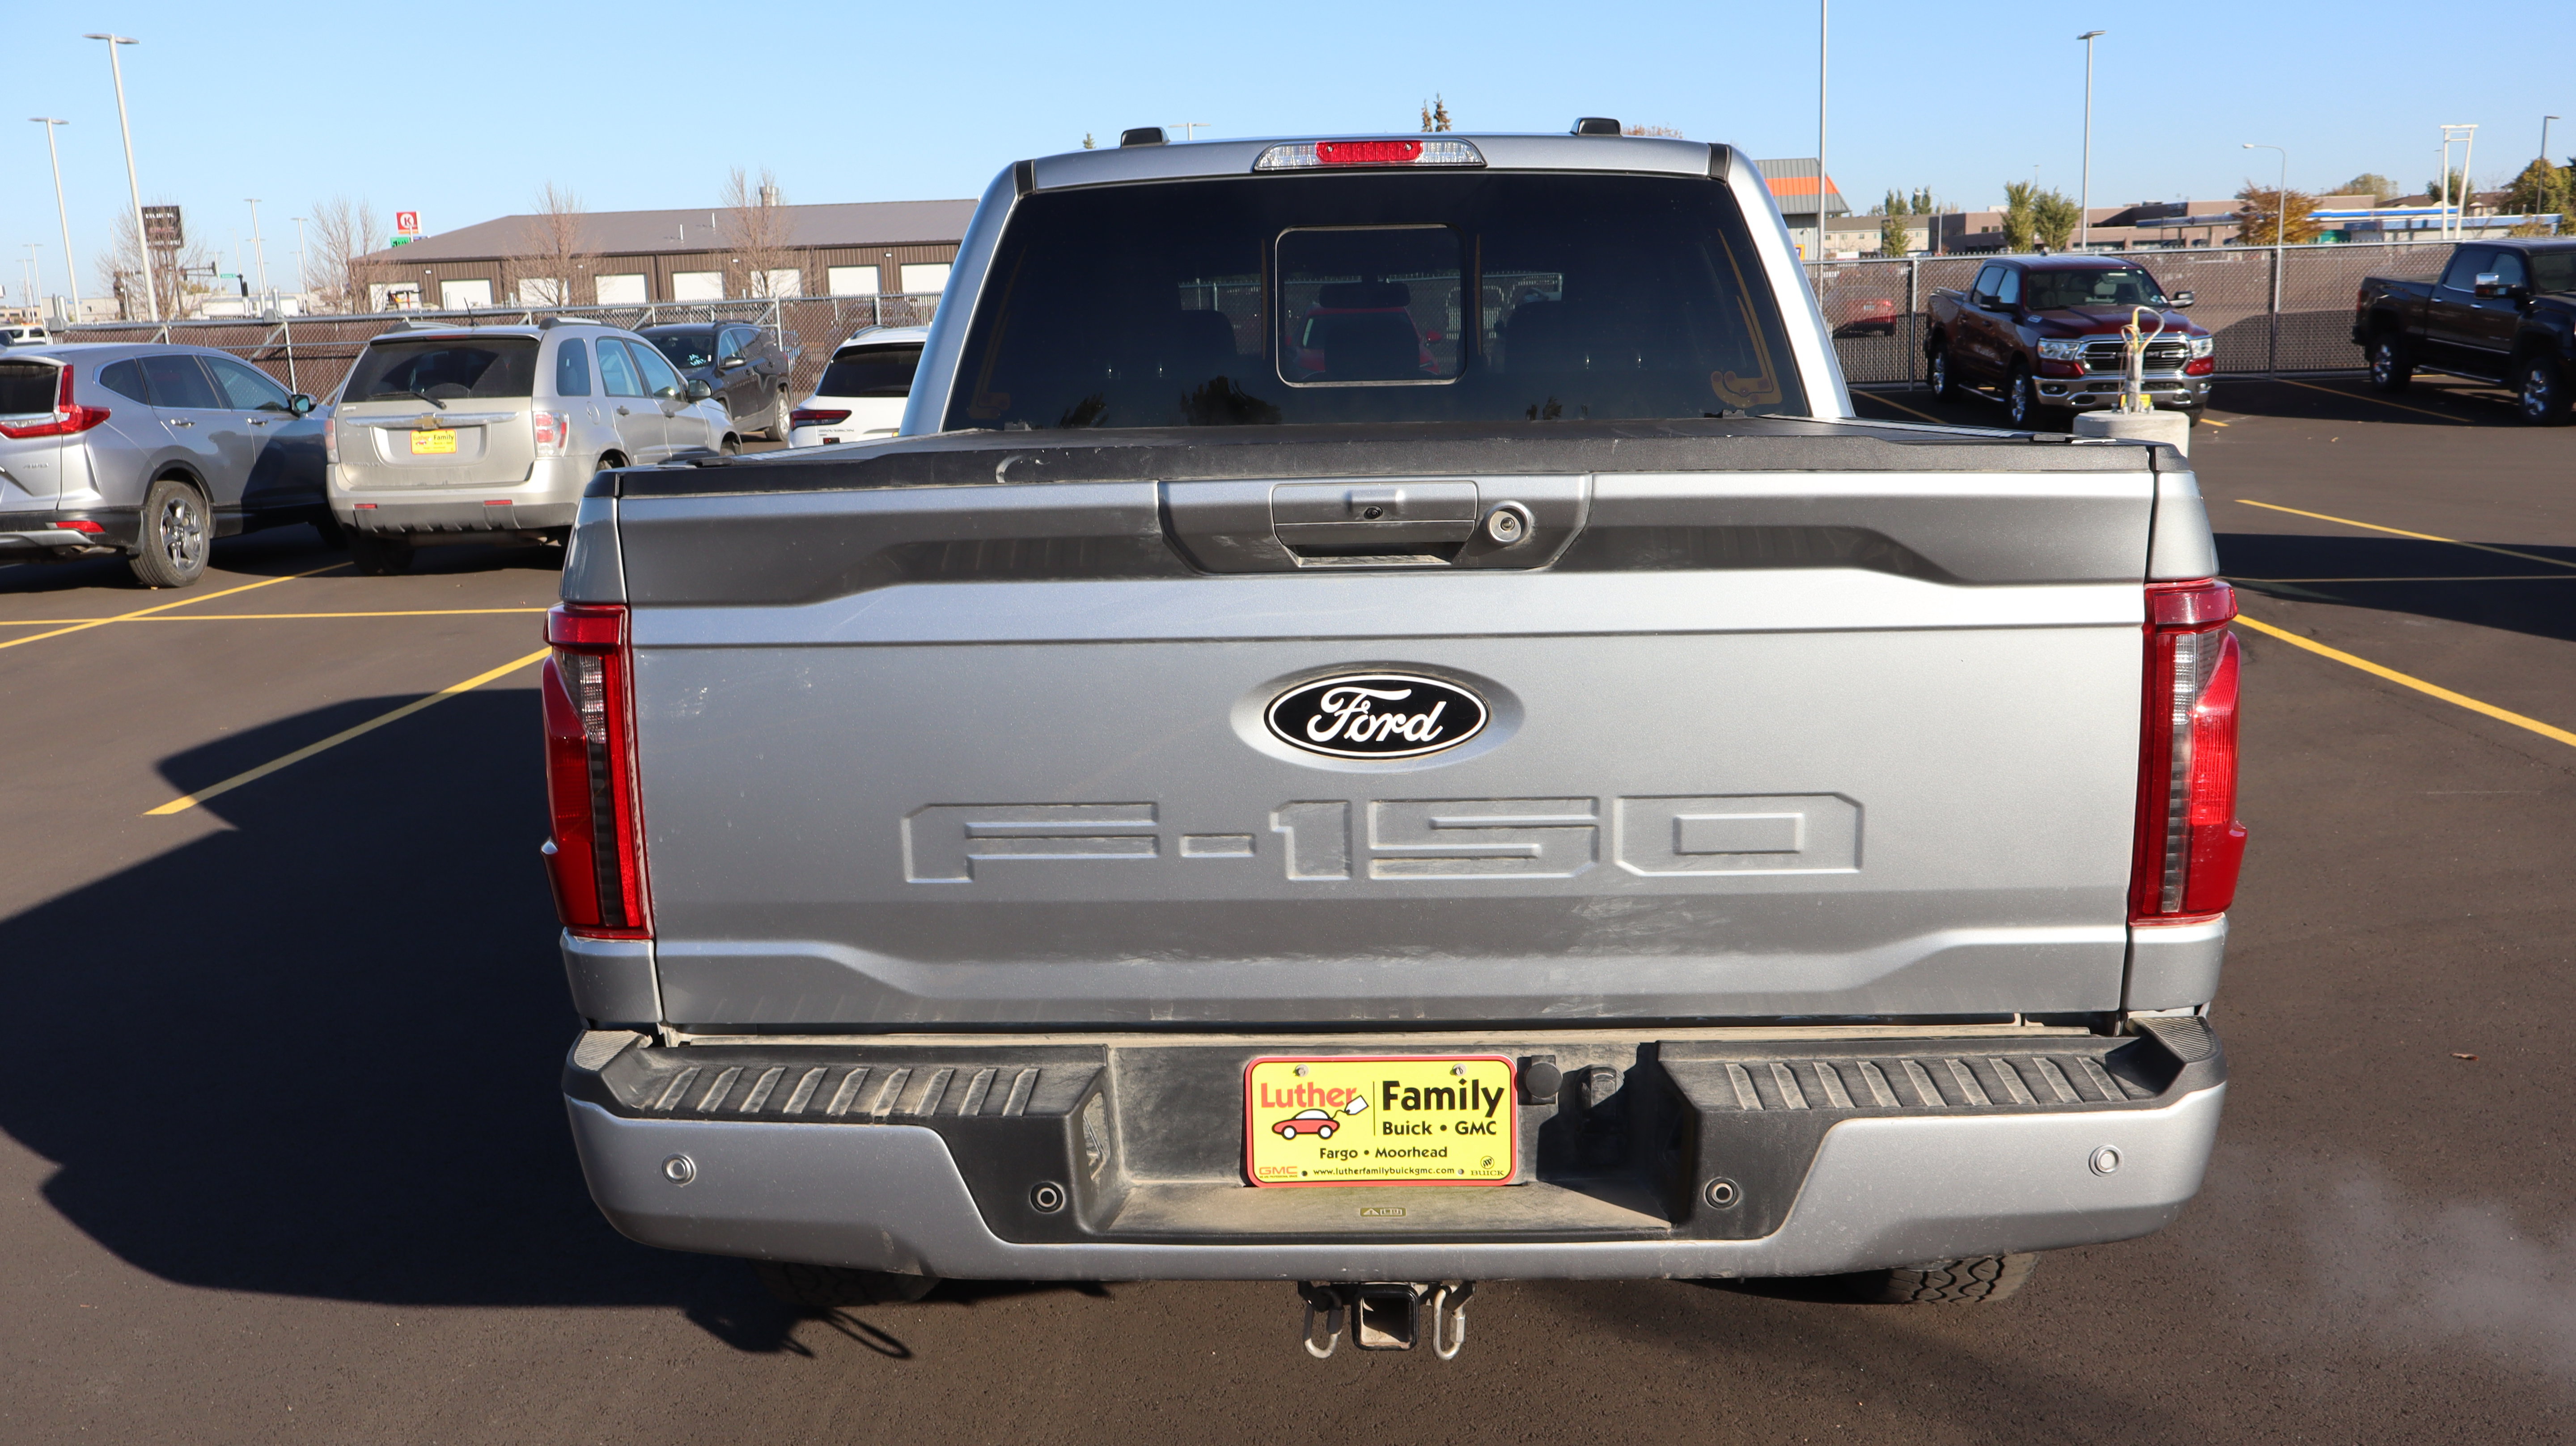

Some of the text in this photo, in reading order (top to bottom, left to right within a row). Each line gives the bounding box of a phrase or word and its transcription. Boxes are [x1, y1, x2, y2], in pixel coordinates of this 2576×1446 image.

[404, 216, 411, 226] K
[1306, 686, 1447, 742] Ford
[901, 793, 1865, 884] F-150
[1261, 1078, 1504, 1118] Luther Family
[1383, 1120, 1497, 1135] Buick GMC
[1320, 1146, 1447, 1161] Fargo Moorhead
[1259, 1166, 1297, 1175] GMC
[1313, 1167, 1454, 1175] www.lutherfamilybuickgmc.com
